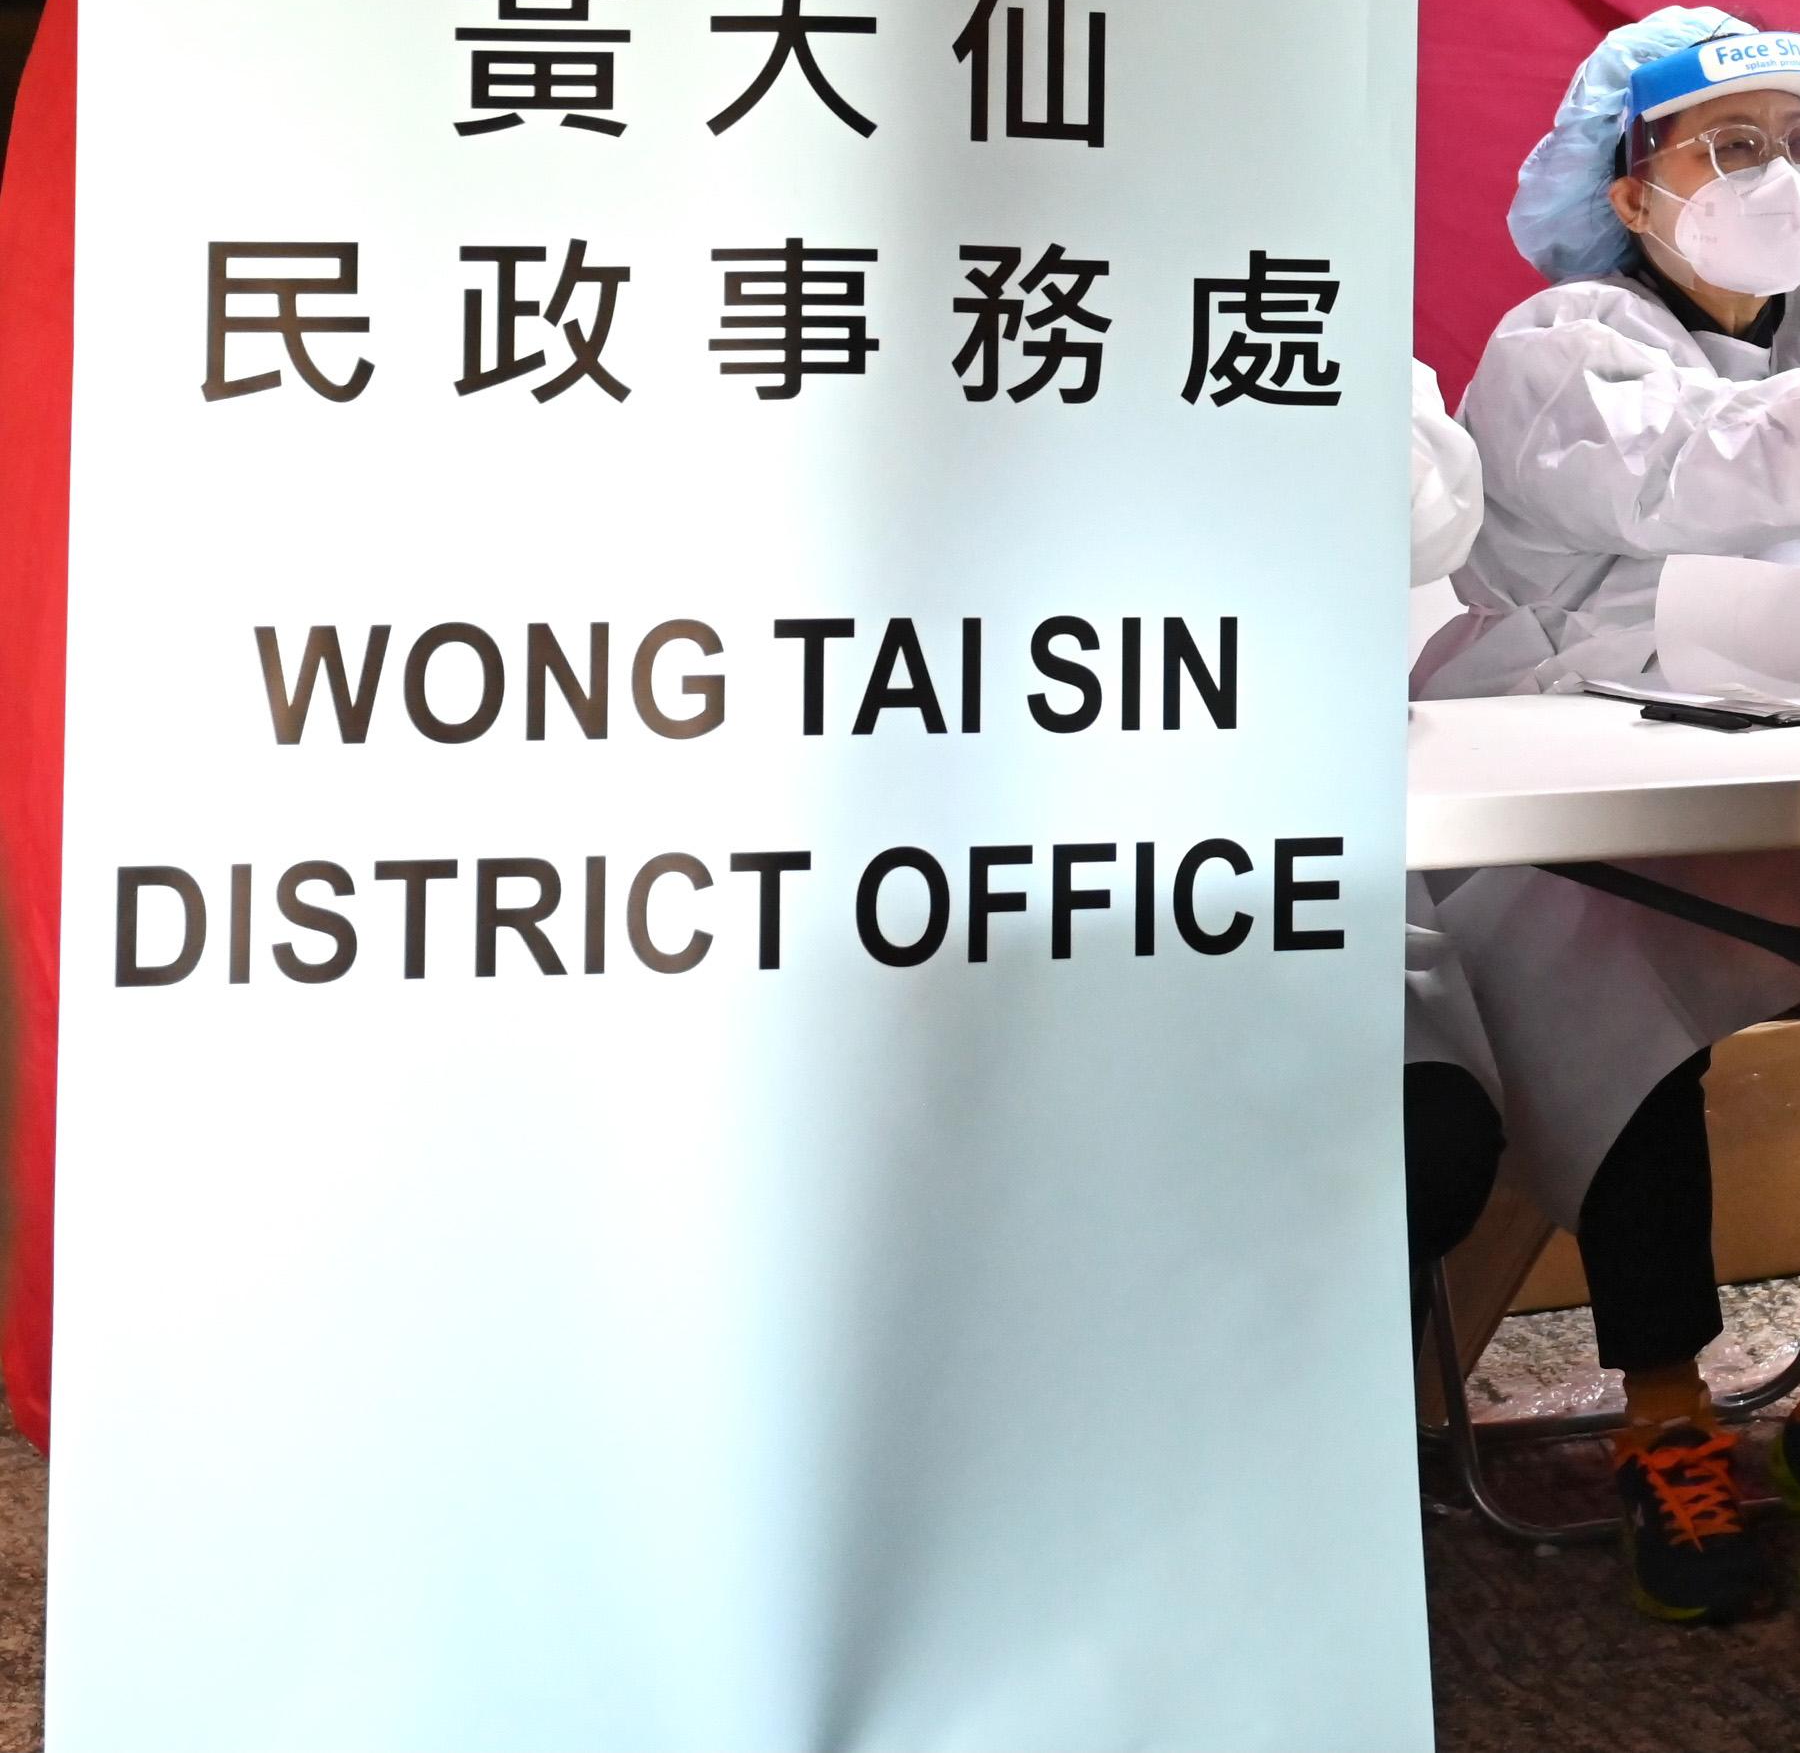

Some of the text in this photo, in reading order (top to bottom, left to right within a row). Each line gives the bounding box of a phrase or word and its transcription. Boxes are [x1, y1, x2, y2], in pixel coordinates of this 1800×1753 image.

[1715, 43, 1769, 65] Face
[1745, 59, 1777, 71] splash
[200, 237, 1342, 408] 民政事務處
[254, 615, 1238, 745] WONG TAI SIN
[115, 836, 1345, 988] DISTRICT OFFICE
